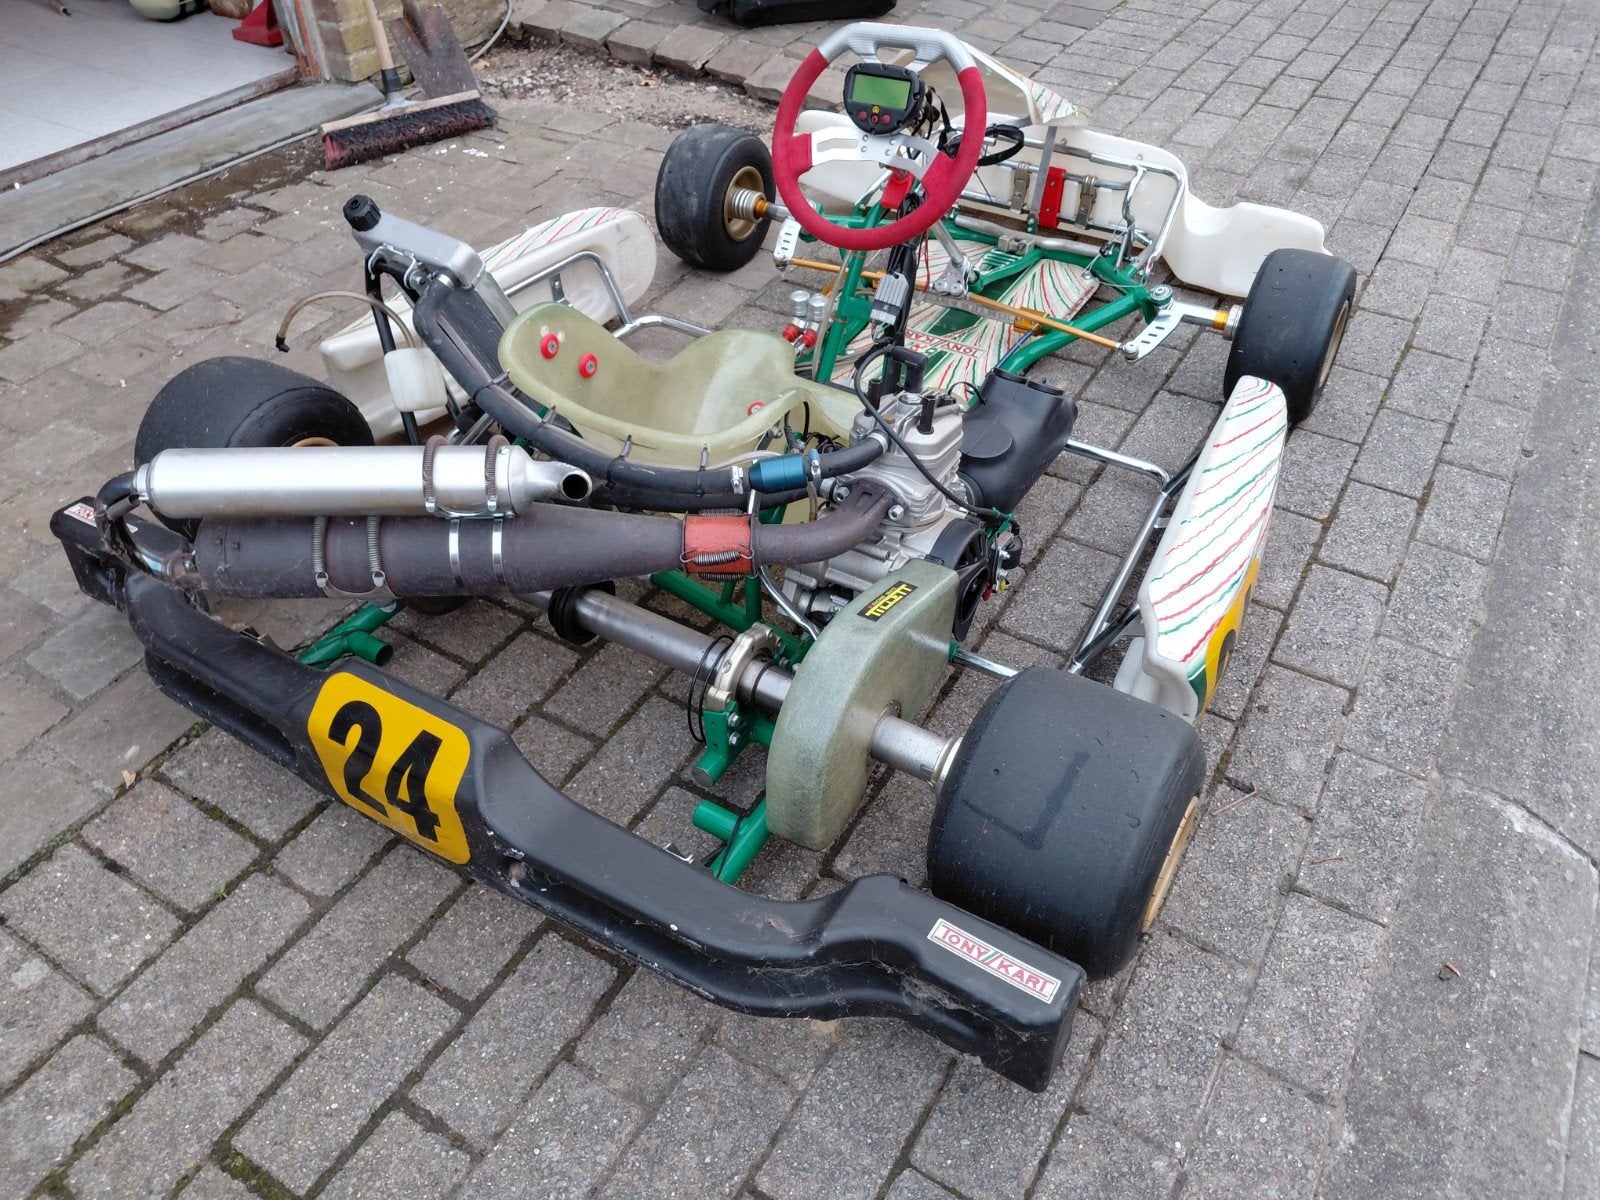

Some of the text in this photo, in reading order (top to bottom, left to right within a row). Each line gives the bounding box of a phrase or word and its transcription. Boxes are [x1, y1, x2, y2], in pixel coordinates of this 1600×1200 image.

[904, 329, 934, 345] KAR
[328, 700, 443, 843] 24
[997, 959, 1054, 993] KART
